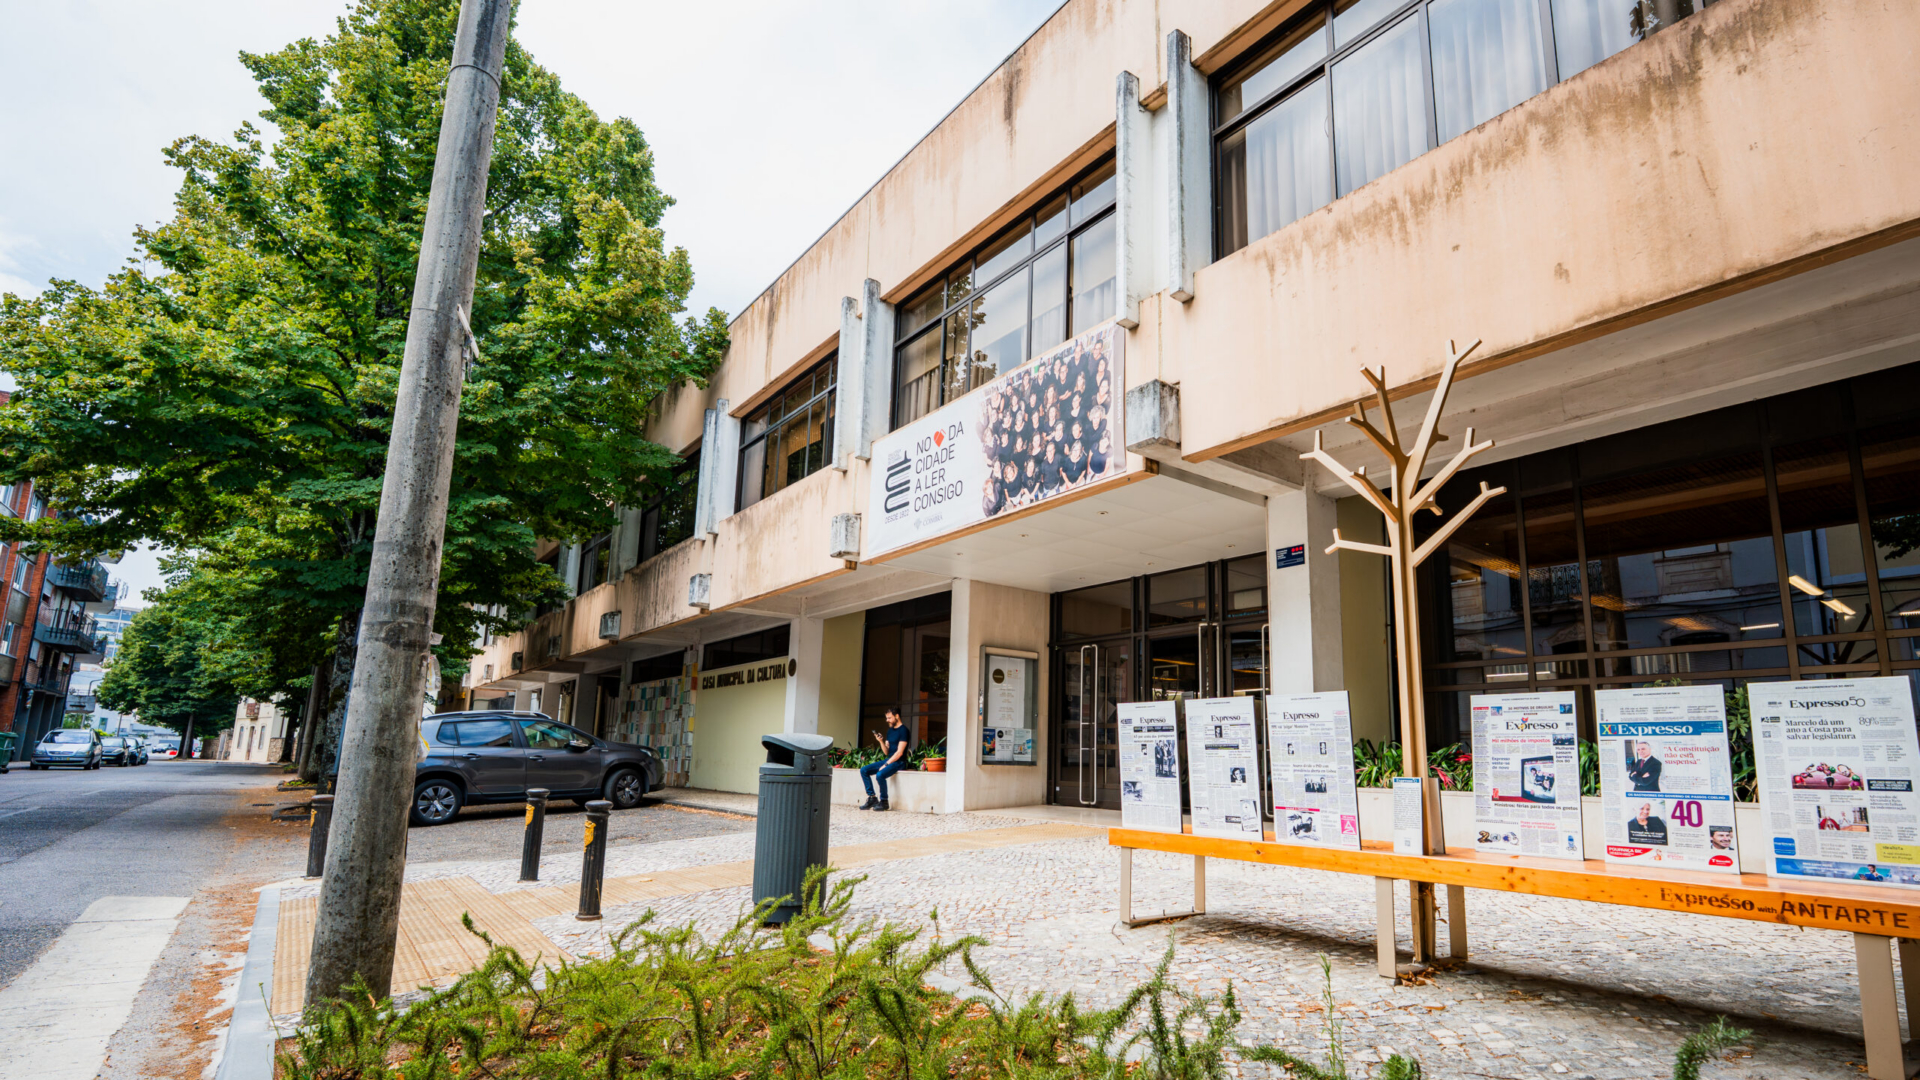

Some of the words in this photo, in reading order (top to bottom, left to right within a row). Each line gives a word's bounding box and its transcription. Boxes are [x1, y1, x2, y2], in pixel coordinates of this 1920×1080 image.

[916, 436, 932, 456] NO
[948, 421, 964, 440] DA
[916, 444, 956, 474] CIDADE
[914, 478, 922, 494] A
[924, 468, 946, 490] LER
[914, 480, 963, 512] CONSIGO
[702, 676, 716, 690] CASA
[716, 670, 745, 688] MUNICIPAL
[746, 668, 755, 684] DA
[757, 664, 786, 682] CULTURA
[1790, 699, 1849, 710] Expresso
[1849, 696, 1866, 707] 50
[1140, 716, 1166, 724] Expresso
[1210, 714, 1240, 722] Expresso
[1282, 712, 1320, 721] Expresso
[1506, 721, 1558, 731] Expresso
[1858, 716, 1880, 726] 89%
[1618, 724, 1694, 736] Expresso
[1670, 800, 1704, 828] 40
[1660, 888, 1755, 912] Expresso
[1757, 905, 1778, 914] with
[1780, 900, 1910, 928] ANTARTE
